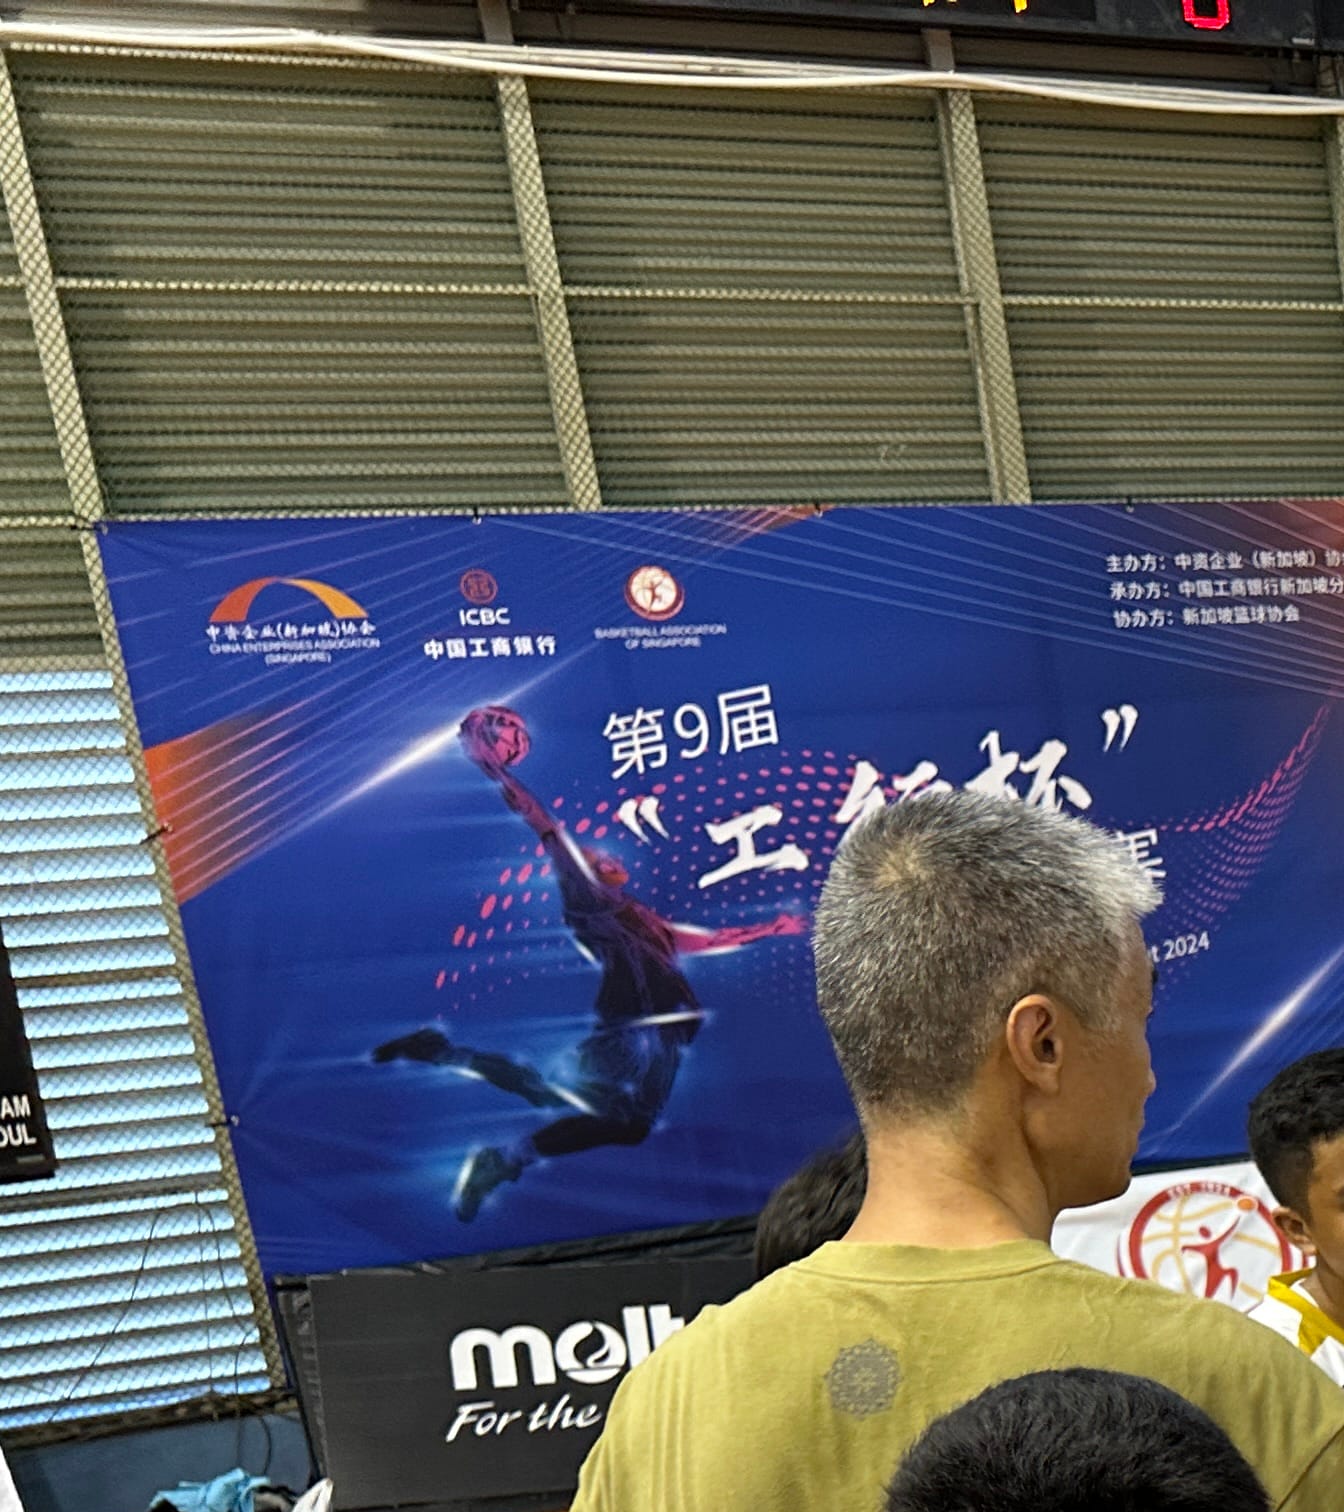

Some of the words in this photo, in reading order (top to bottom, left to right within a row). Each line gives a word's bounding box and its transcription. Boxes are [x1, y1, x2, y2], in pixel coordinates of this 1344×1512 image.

[459, 607, 511, 626] ICBC
[314, 636, 381, 650] ASSOCIATION
[423, 635, 556, 660] 中国工商银行
[602, 683, 779, 779] 第9届
[1163, 930, 1210, 961] 2024
[446, 1401, 523, 1443] For
[526, 1393, 603, 1433] the
